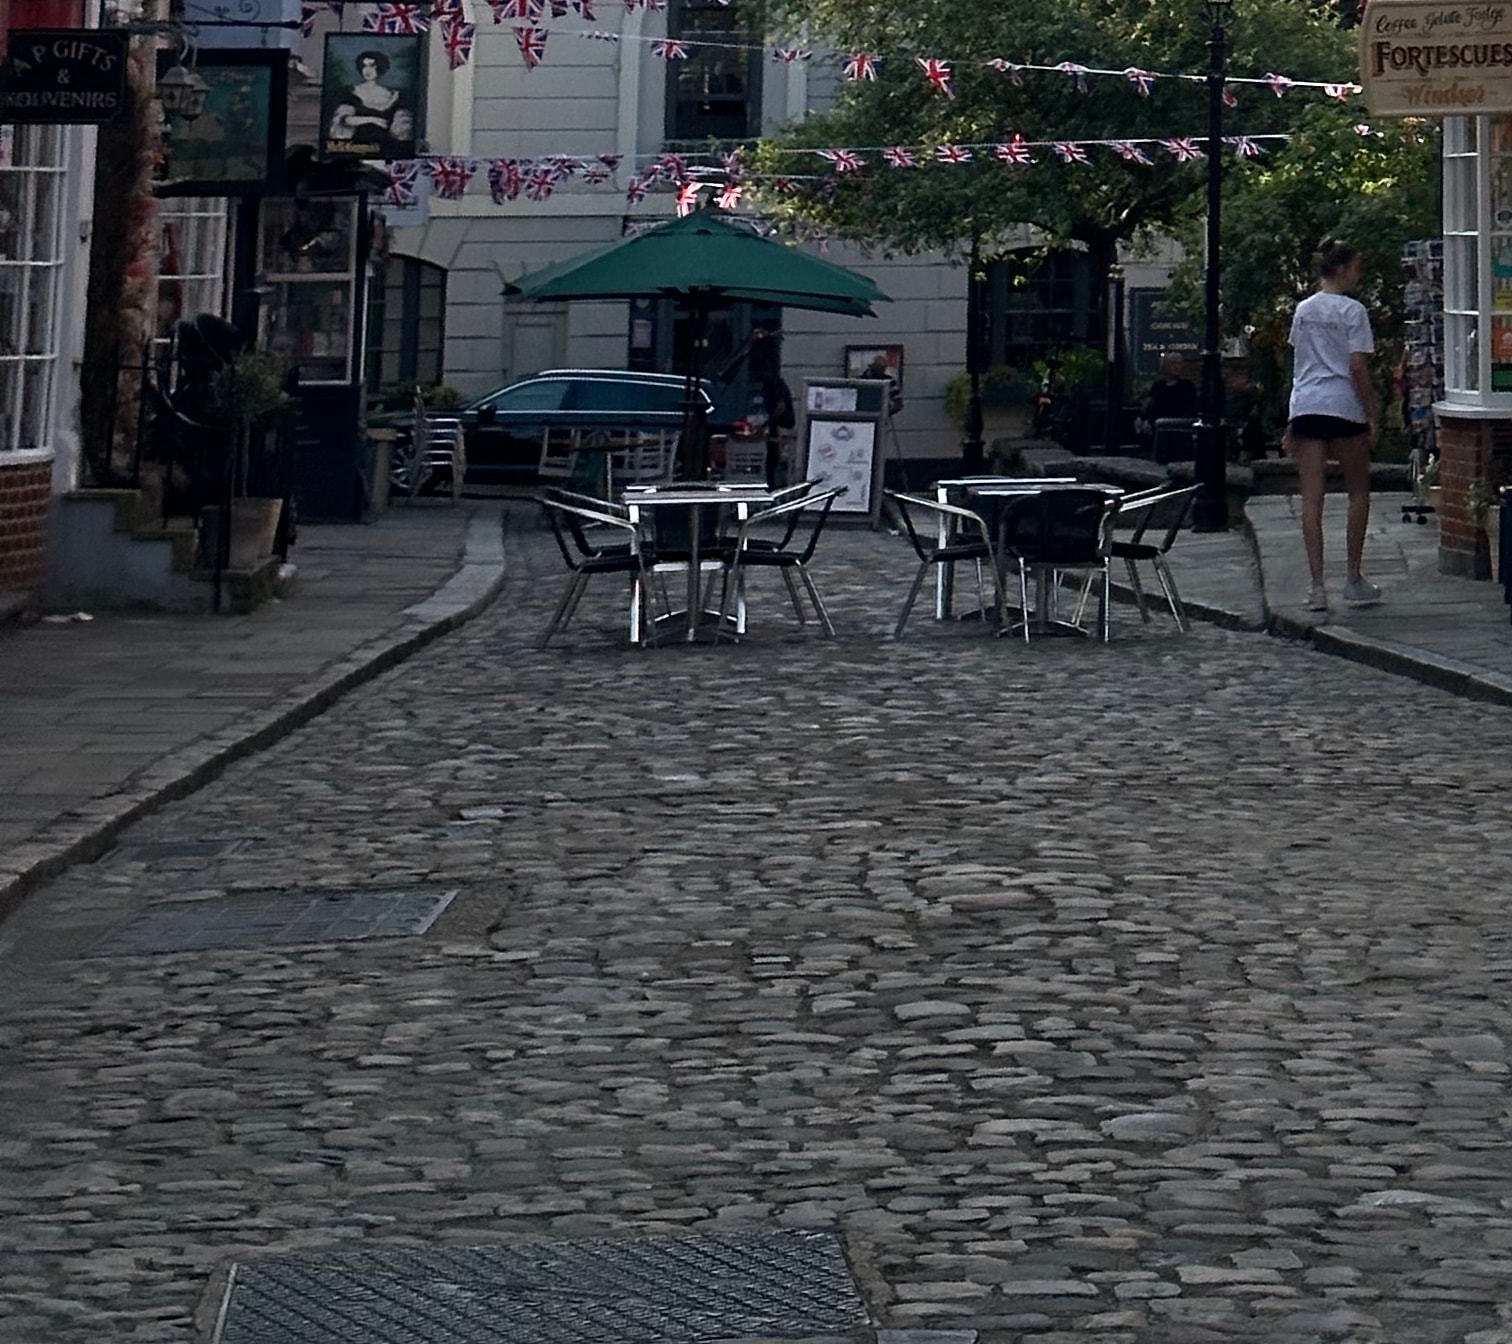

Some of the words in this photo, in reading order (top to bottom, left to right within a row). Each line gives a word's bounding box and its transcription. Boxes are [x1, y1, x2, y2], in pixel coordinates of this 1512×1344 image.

[1376, 14, 1417, 35] Coffee
[52, 40, 117, 72] GIFTS
[57, 68, 71, 84] &
[1403, 81, 1486, 106] Windsor
